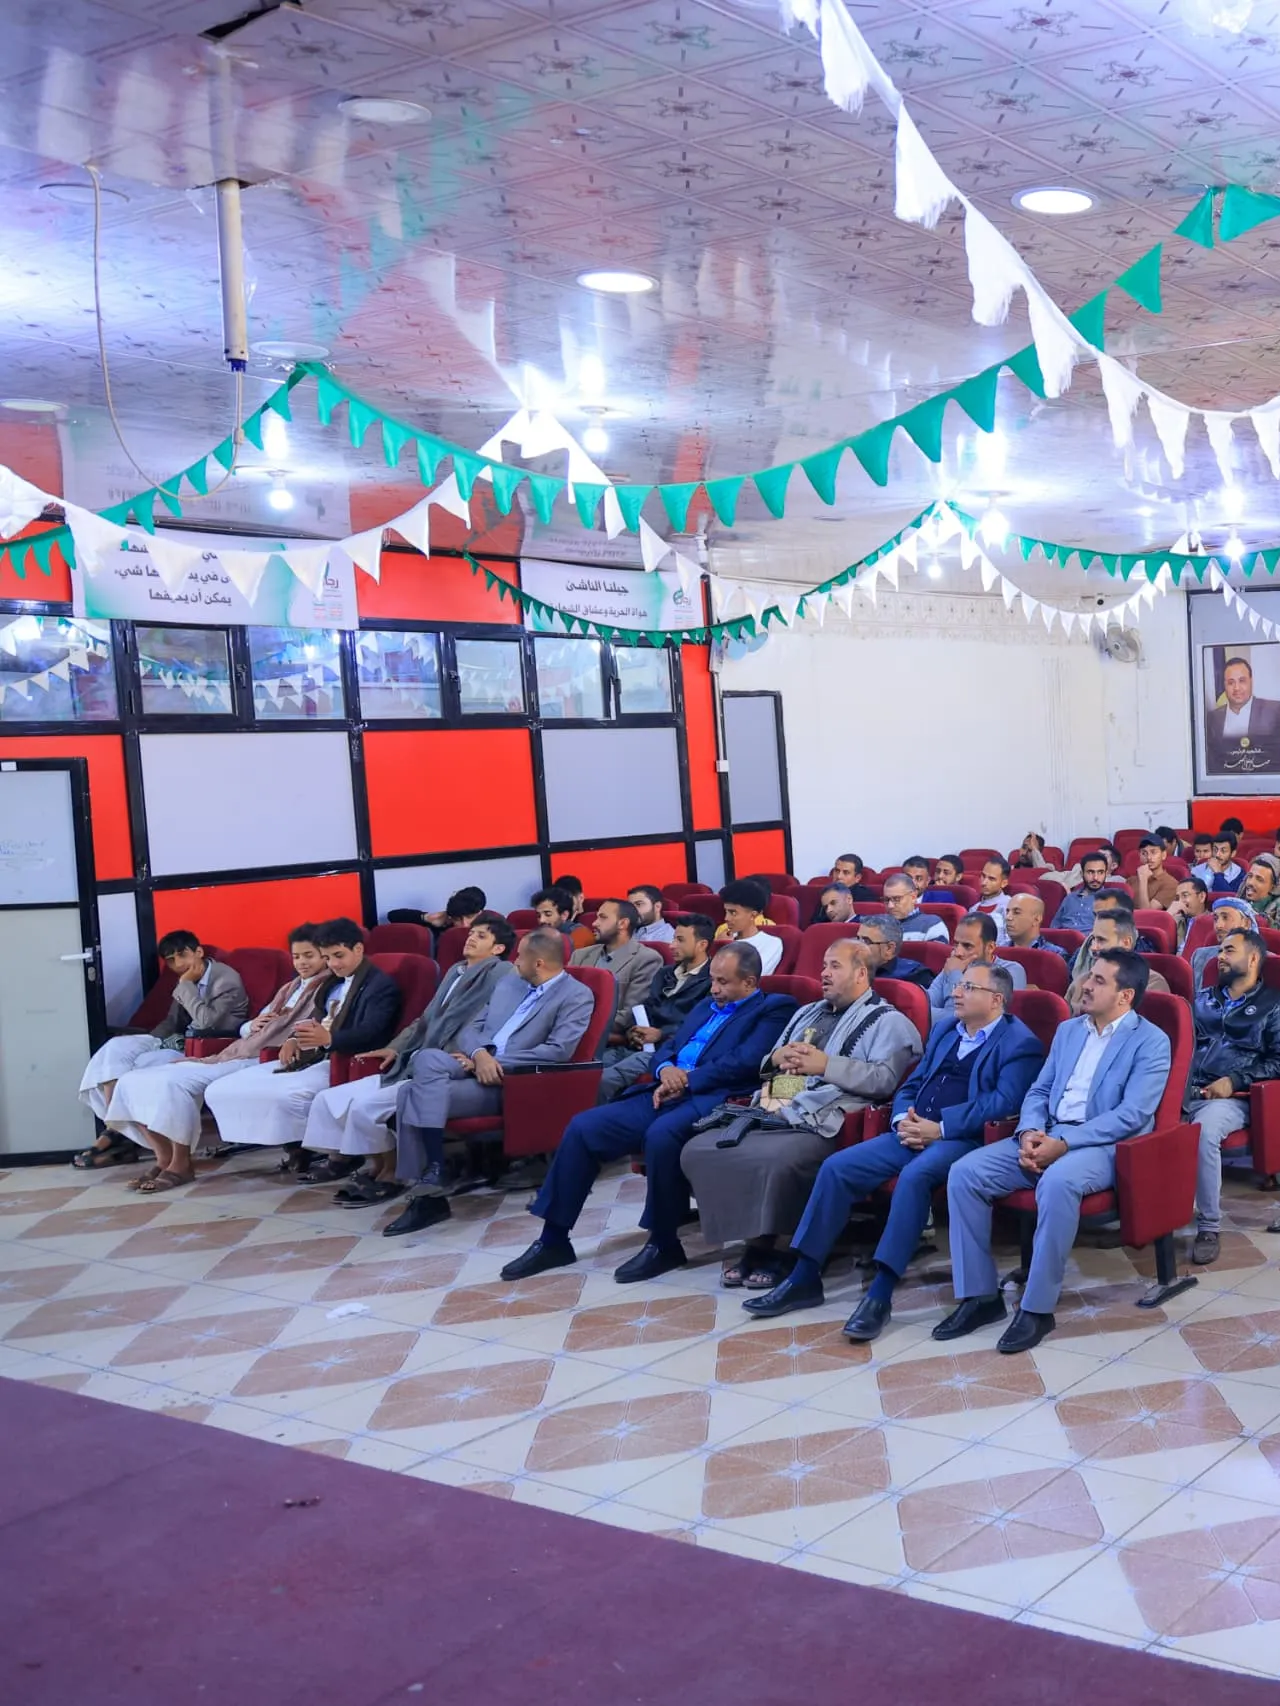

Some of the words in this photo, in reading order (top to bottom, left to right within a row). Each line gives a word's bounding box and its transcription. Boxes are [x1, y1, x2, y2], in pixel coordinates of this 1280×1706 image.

[602, 581, 629, 596] جيلنا
[190, 589, 202, 603] أن
[204, 592, 232, 606] يمكن
